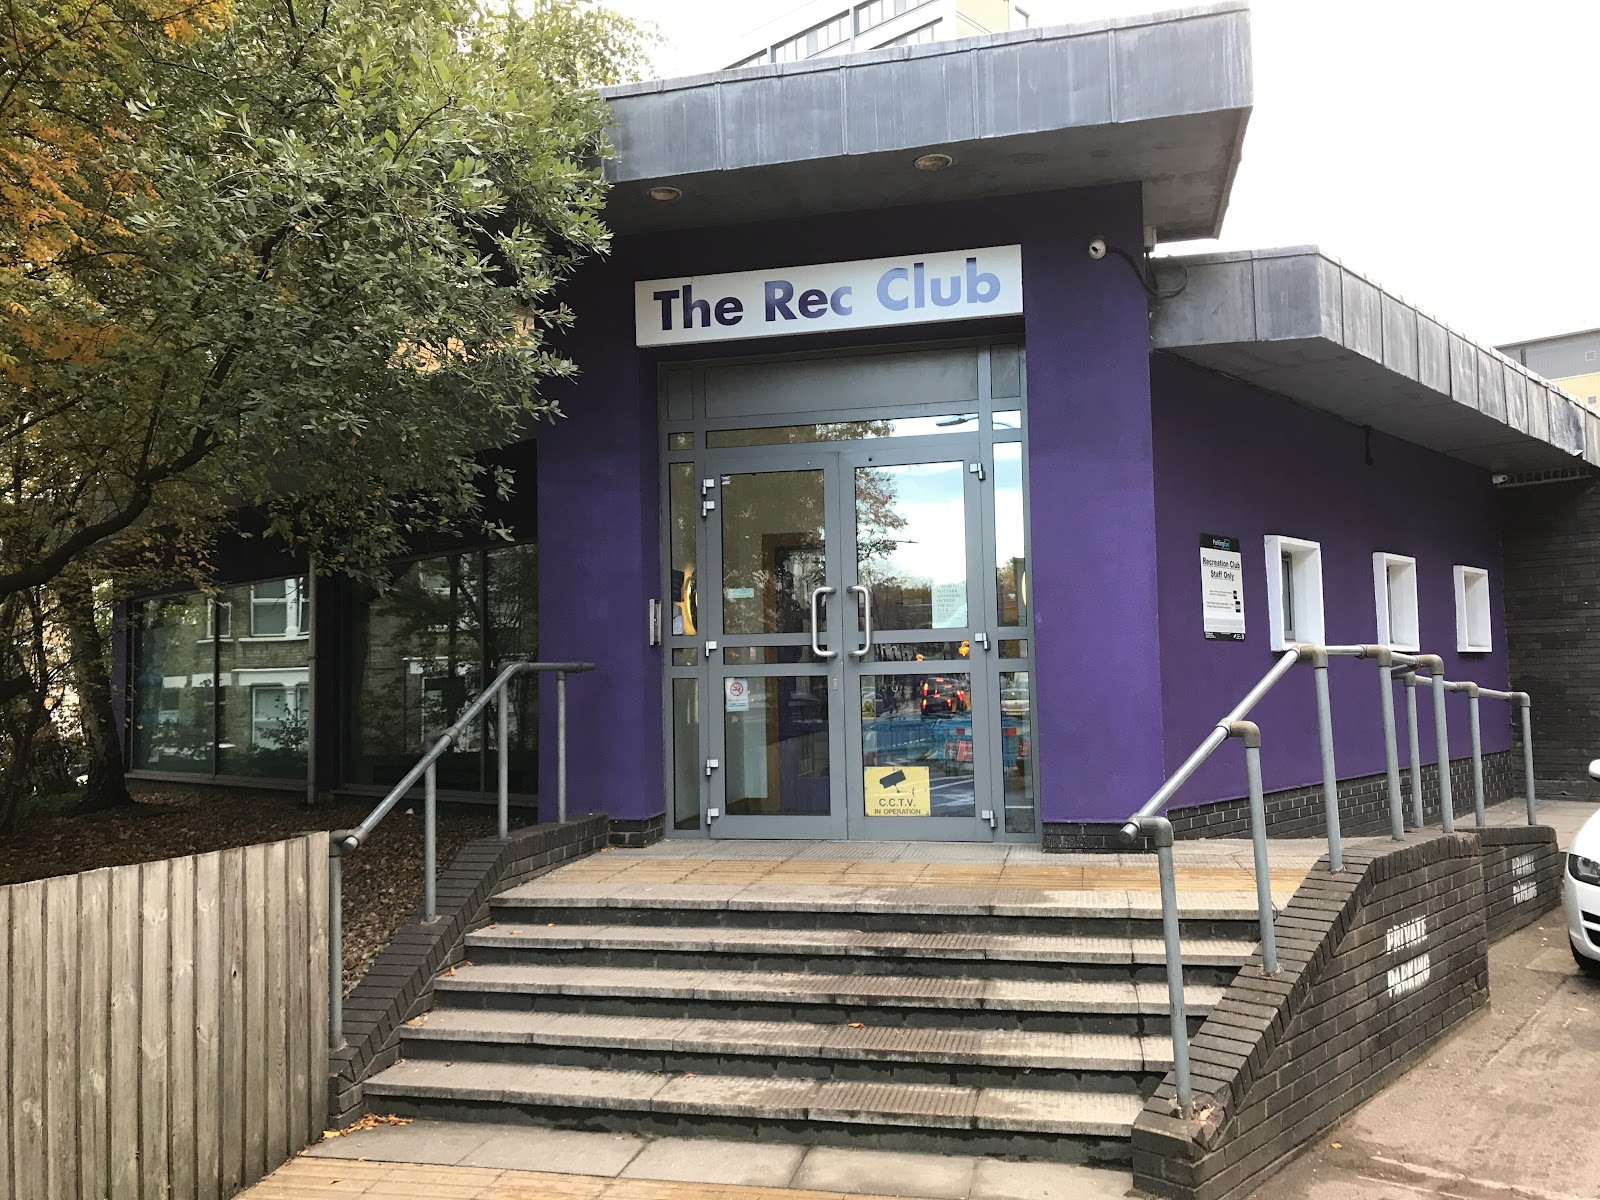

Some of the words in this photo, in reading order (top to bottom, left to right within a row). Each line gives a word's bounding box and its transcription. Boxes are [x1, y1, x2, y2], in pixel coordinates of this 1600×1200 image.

[654, 284, 744, 331] The
[764, 279, 853, 322] Rec
[876, 257, 1001, 312] Club
[1203, 557, 1229, 567] Recreation
[1224, 571, 1234, 581] Only
[879, 798, 916, 807] C.C.T.V.
[1386, 915, 1428, 955] PRIVATE
[1387, 953, 1431, 998] PARKING
